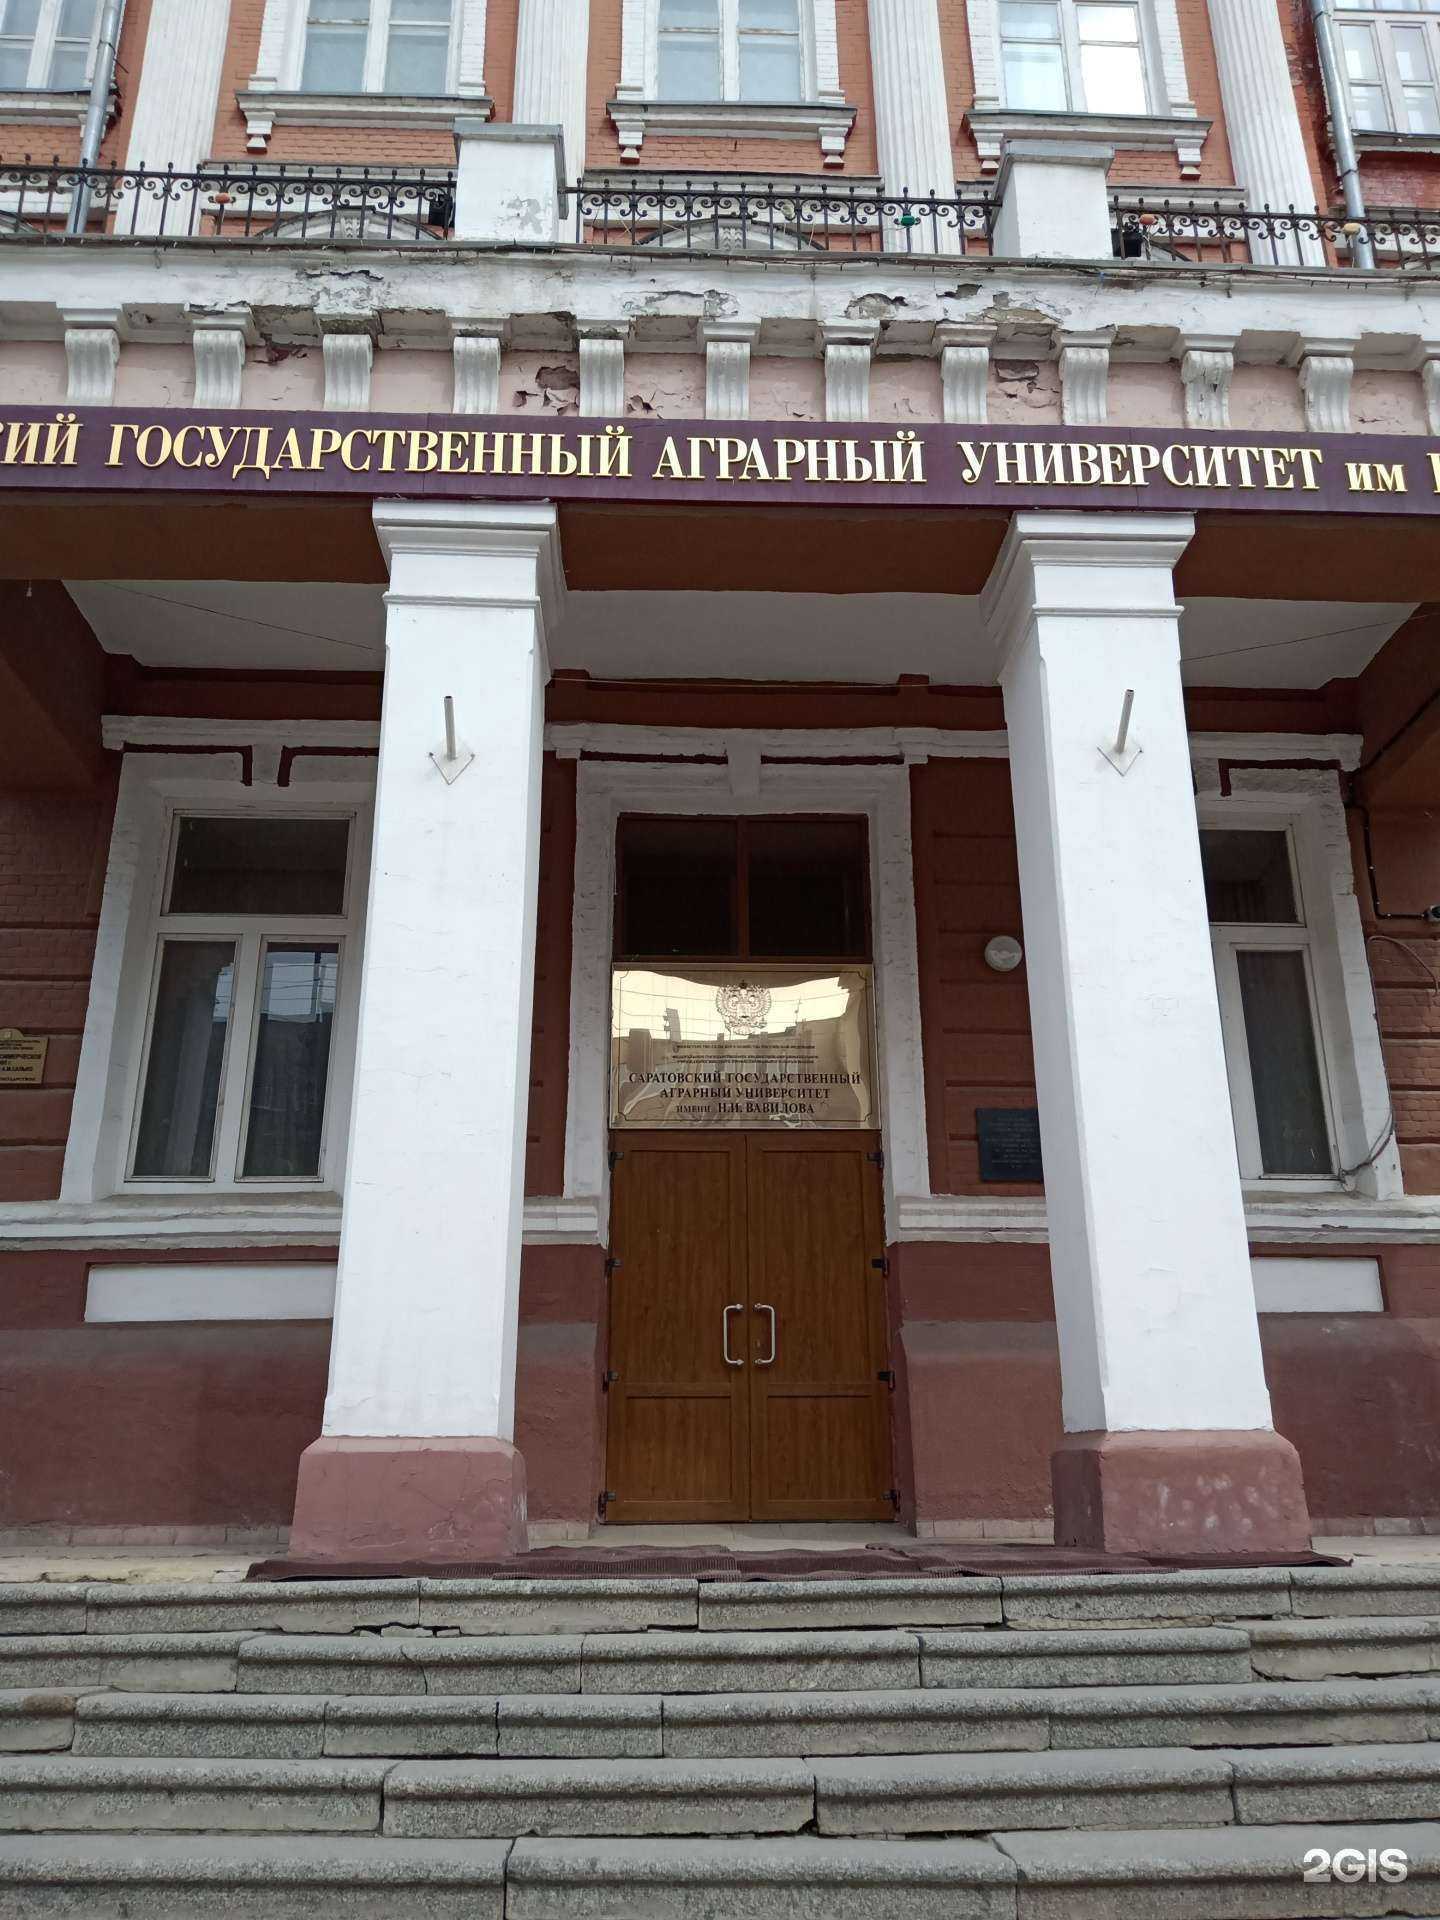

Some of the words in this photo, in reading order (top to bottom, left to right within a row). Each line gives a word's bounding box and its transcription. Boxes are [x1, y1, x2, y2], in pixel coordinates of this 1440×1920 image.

[0, 412, 83, 466] ИЙ
[105, 423, 633, 479] ГОСУДАРСТВЕННЫЙ
[652, 429, 928, 483] АГРАРНЫЙ
[957, 440, 1323, 490] УНИВЕРСИТЕТ
[629, 1071, 721, 1083] САРАТОВСКИЙ
[727, 1071, 861, 1085] ГОСУДАРСТВЕННЫЙ
[660, 1085, 731, 1098] АГРАРНЫЙ
[736, 1087, 831, 1099] УНИВЕРСИТЕТ
[746, 1103, 815, 1114] ВАВИЛОВА
